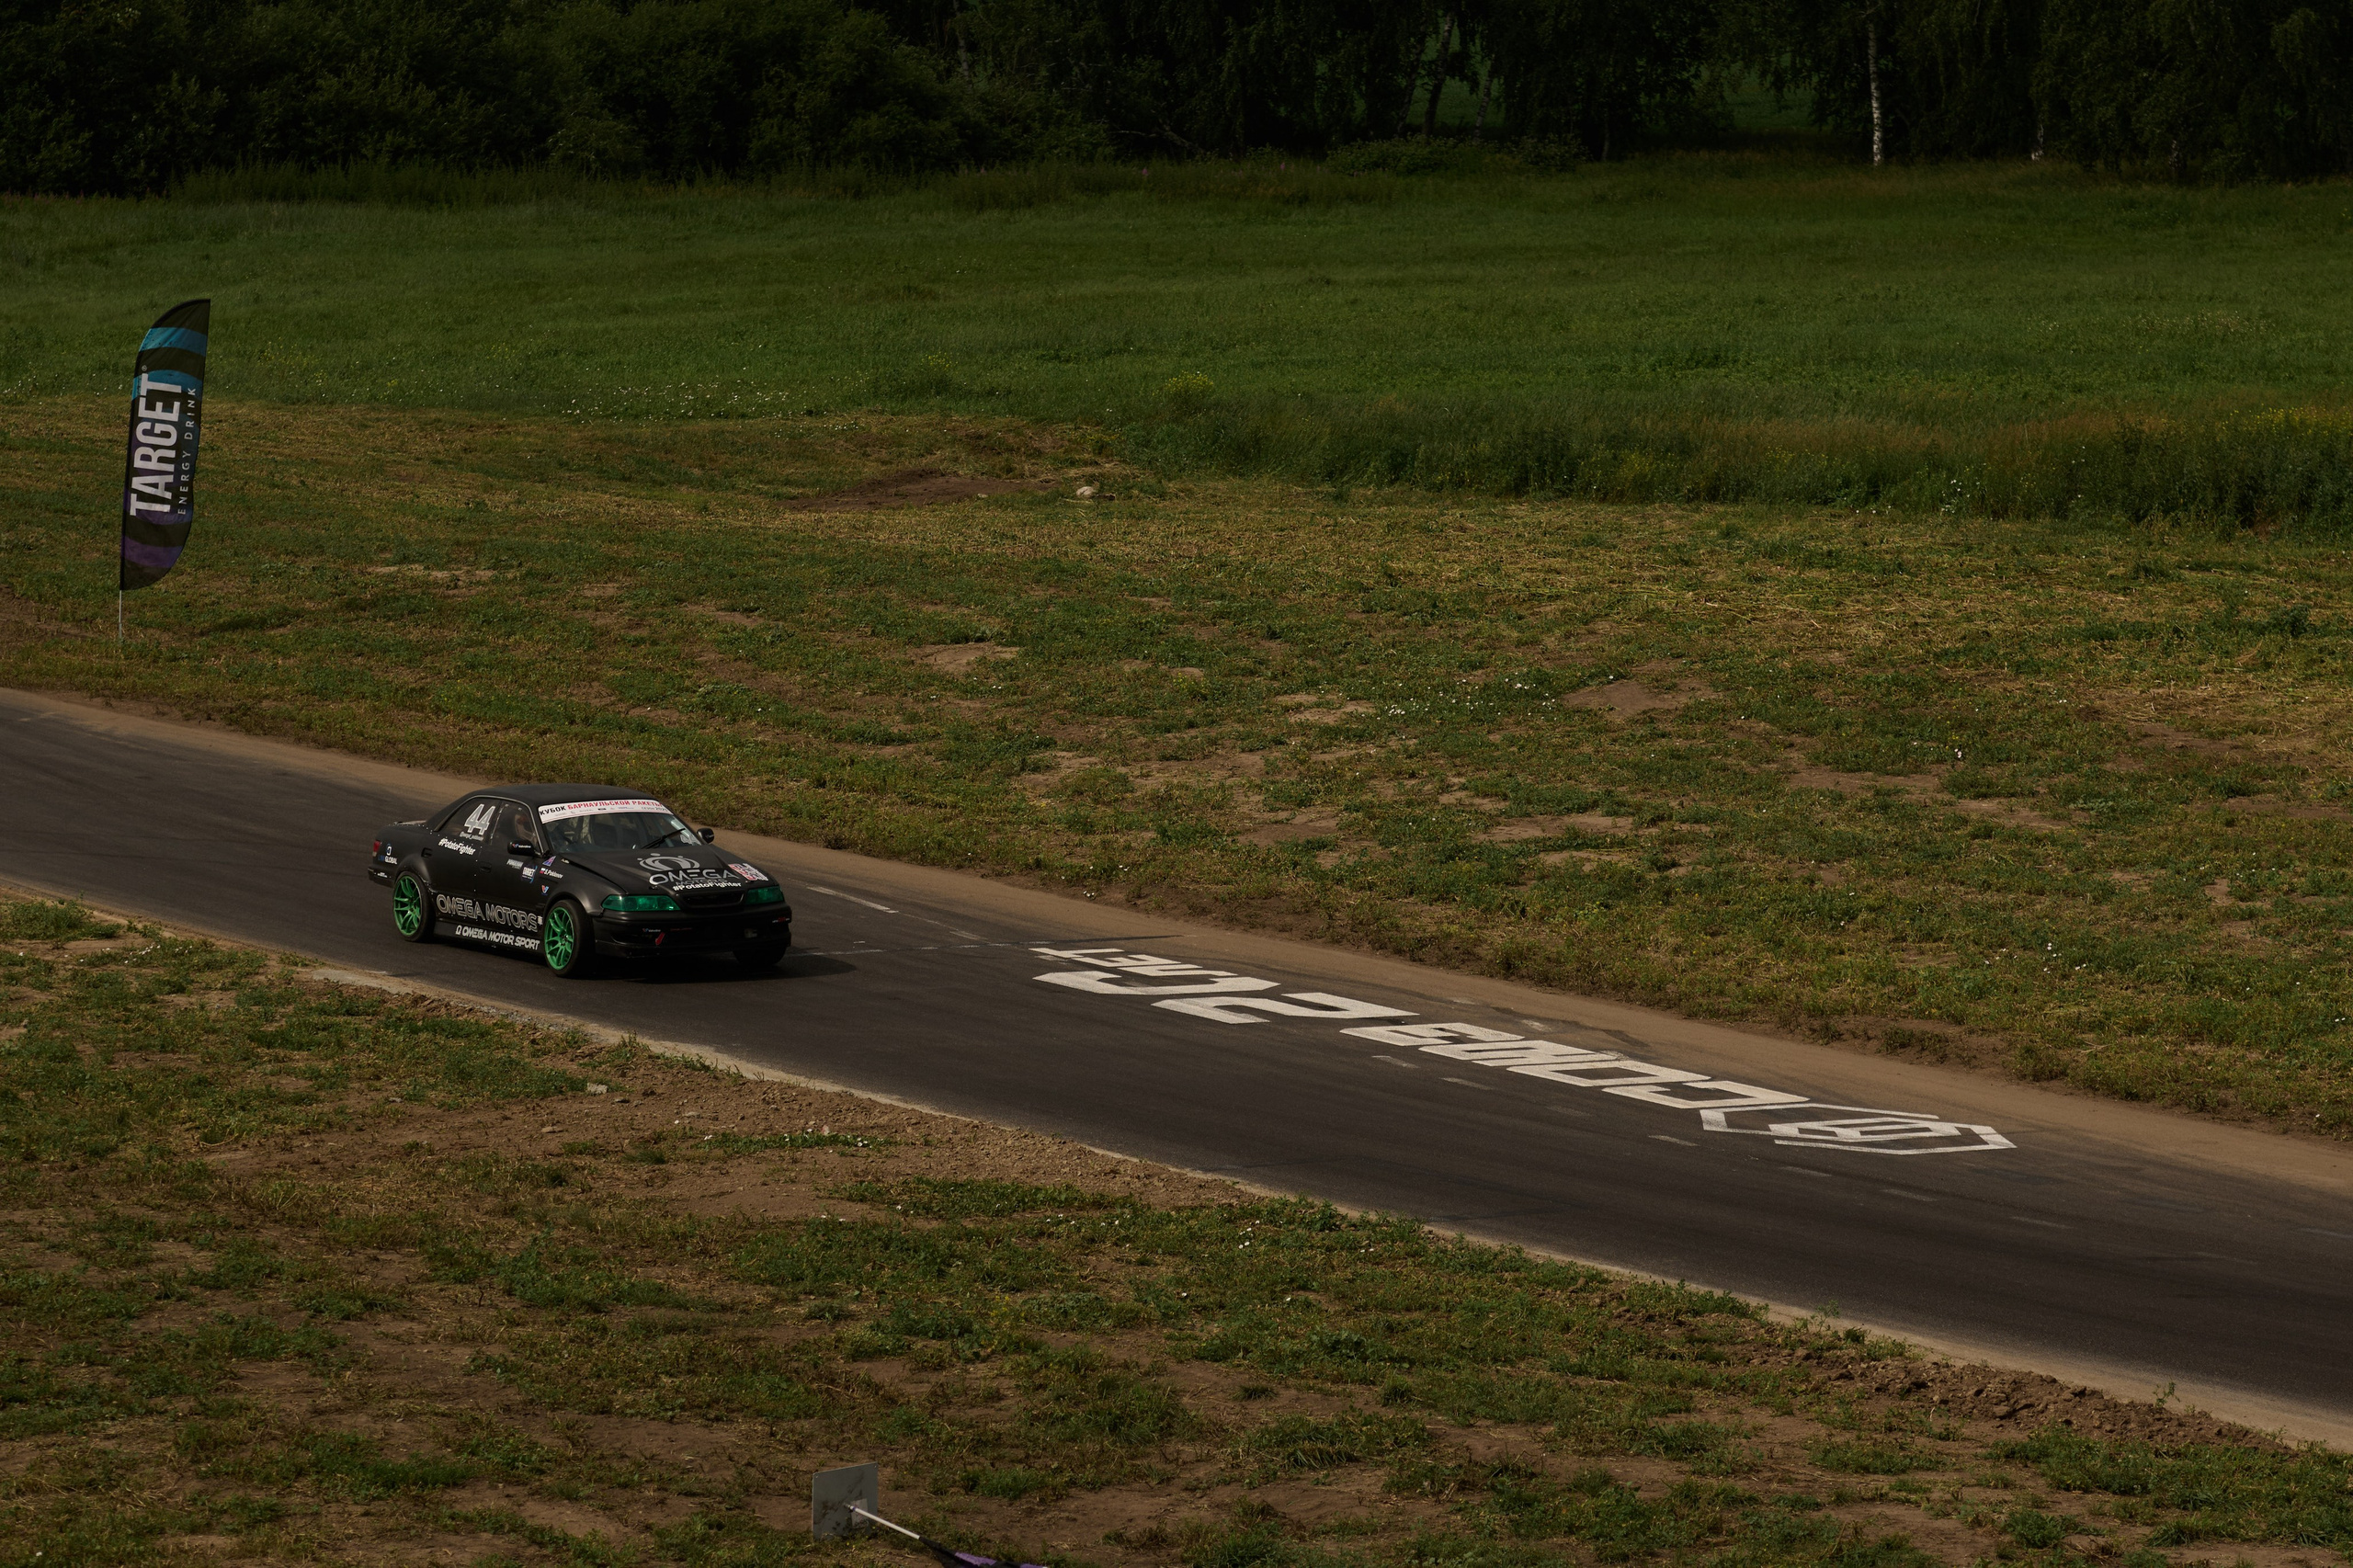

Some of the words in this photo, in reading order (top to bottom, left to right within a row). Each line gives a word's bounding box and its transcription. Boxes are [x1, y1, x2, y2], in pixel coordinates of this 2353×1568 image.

[184, 387, 197, 440] DRINK
[130, 373, 183, 517] TARGET
[177, 451, 192, 516] ENERGY
[463, 803, 496, 835] 44
[539, 805, 566, 816] КУБОК
[567, 800, 631, 810] БАРНАУЛЬСКОЙ
[438, 837, 476, 856] #PotatoFighter
[649, 868, 741, 886] OMEGA
[672, 882, 743, 892] #PotatoFighter
[436, 893, 486, 922] OMEGA
[485, 903, 539, 933] MOTORS
[461, 926, 488, 941] OMEGA
[487, 930, 515, 947] MOTOR
[514, 936, 540, 950] SPORT
